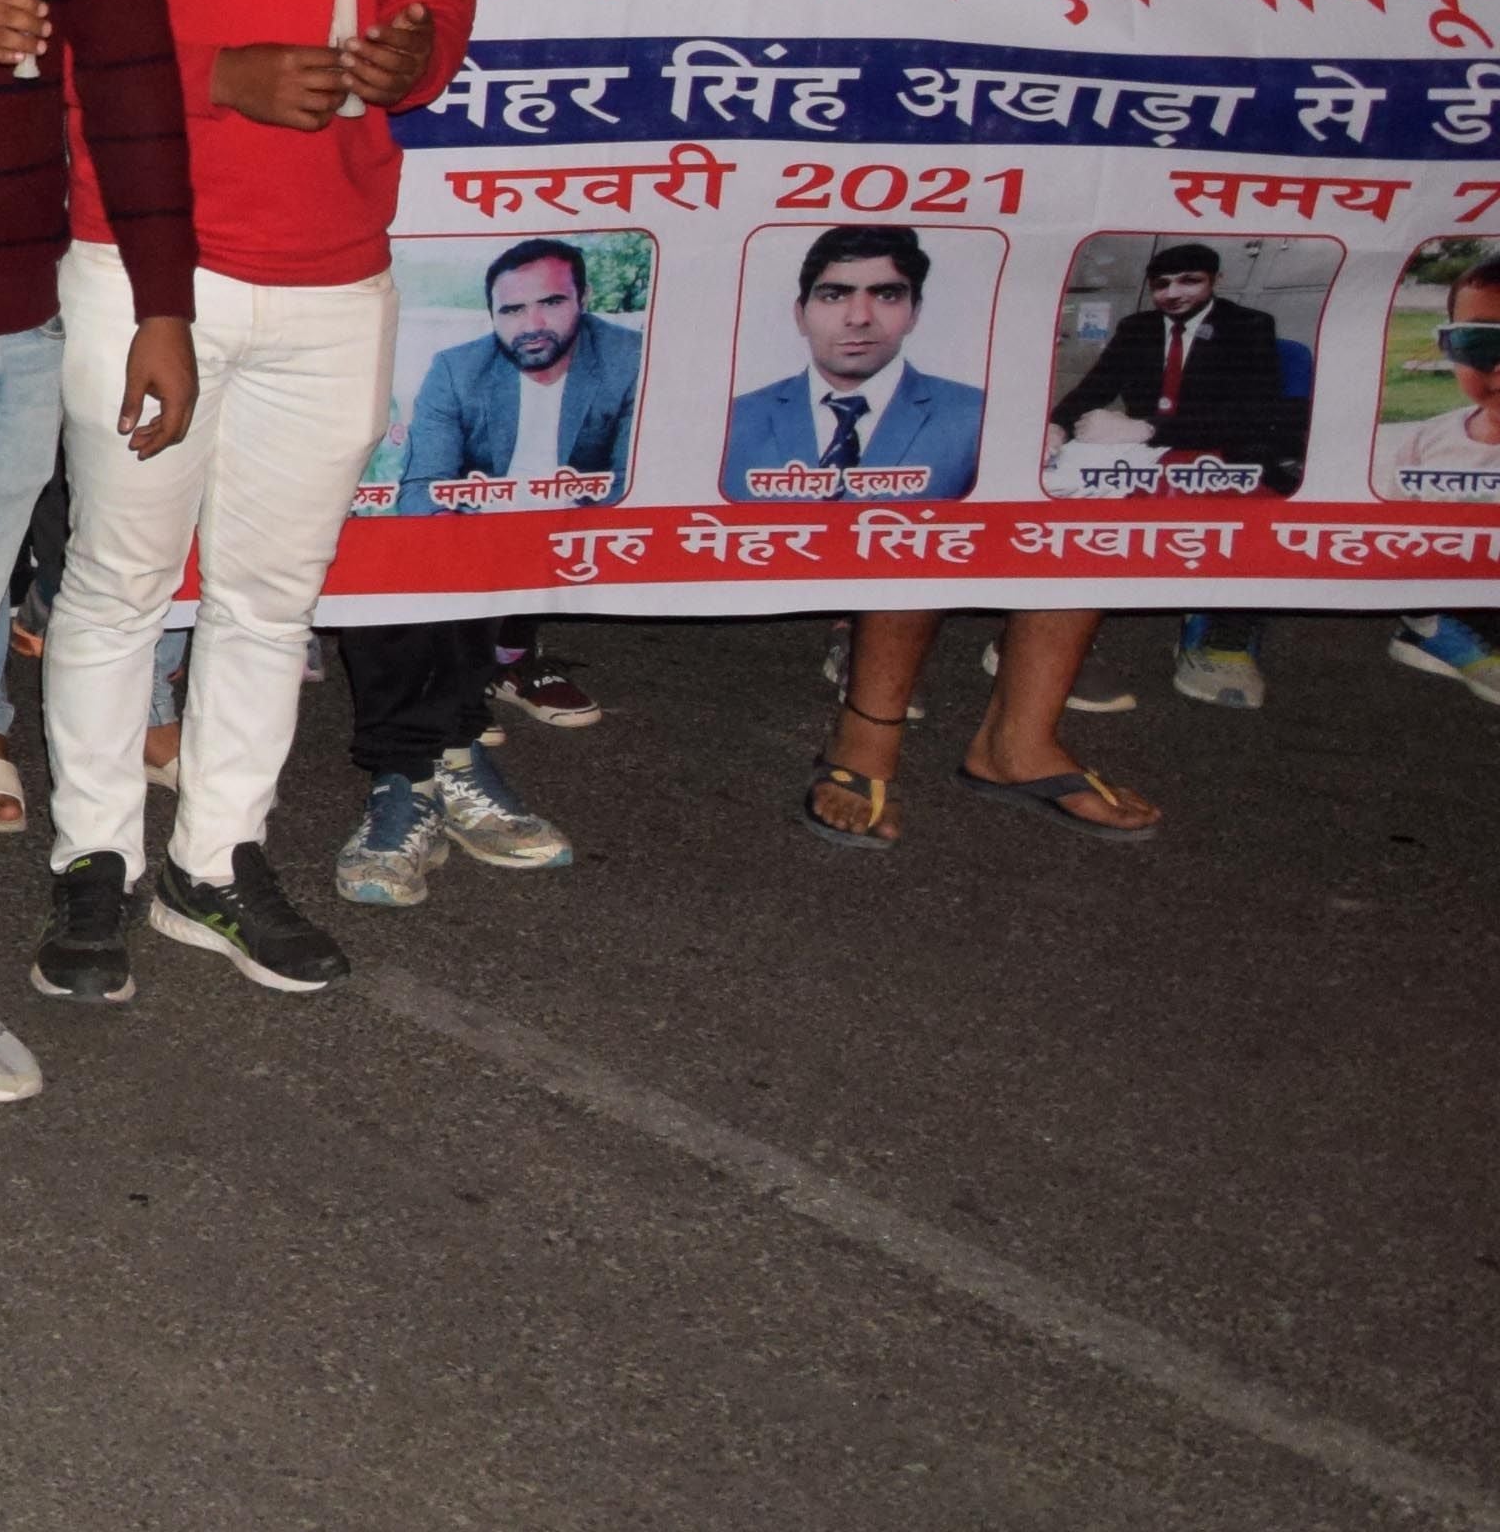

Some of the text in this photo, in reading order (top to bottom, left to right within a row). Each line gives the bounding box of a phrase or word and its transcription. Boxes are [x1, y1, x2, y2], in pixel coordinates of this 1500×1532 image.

[426, 56, 630, 134] मेहर
[661, 41, 861, 131] सिंह
[896, 66, 1256, 147] अखाड़ा
[1294, 65, 1386, 144] से
[444, 143, 737, 218] फरवरी
[774, 161, 1024, 215] 2021
[1169, 170, 1411, 224] समय
[433, 469, 610, 503] मनोज मलिक
[846, 470, 927, 493] दलाल
[1081, 461, 1257, 492] प्रदीप मलिक
[549, 528, 652, 582] गुरु
[680, 514, 828, 564] मेहर
[851, 509, 985, 563] सिंह
[1009, 521, 1243, 570] अखाड़ा
